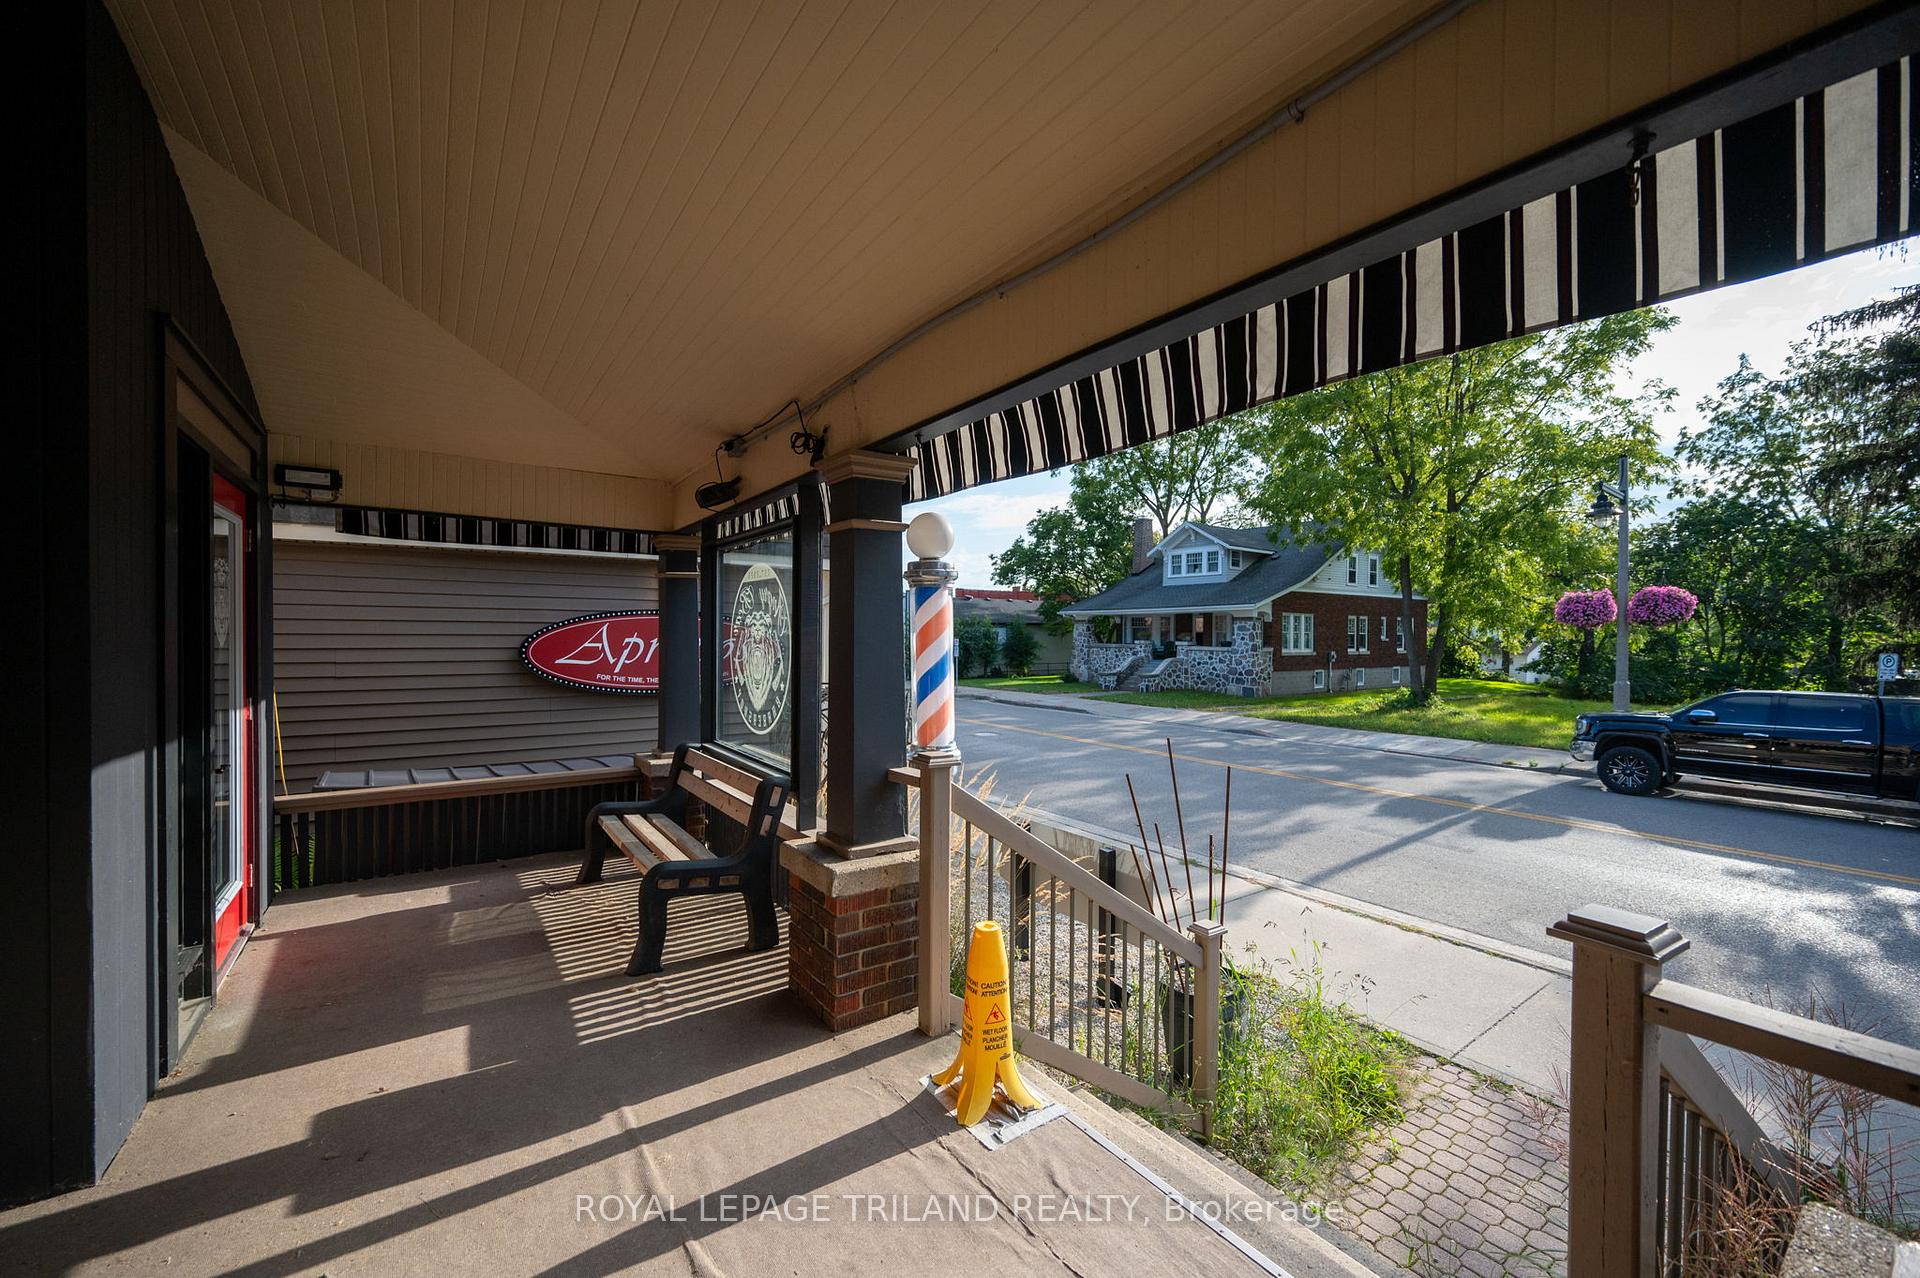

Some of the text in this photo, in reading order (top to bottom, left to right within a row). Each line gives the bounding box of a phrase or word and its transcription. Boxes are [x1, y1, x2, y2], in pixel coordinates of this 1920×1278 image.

[554, 622, 659, 673] Apr
[993, 1026, 1008, 1034] FLOOR
[982, 1034, 1008, 1043] PLANCHER
